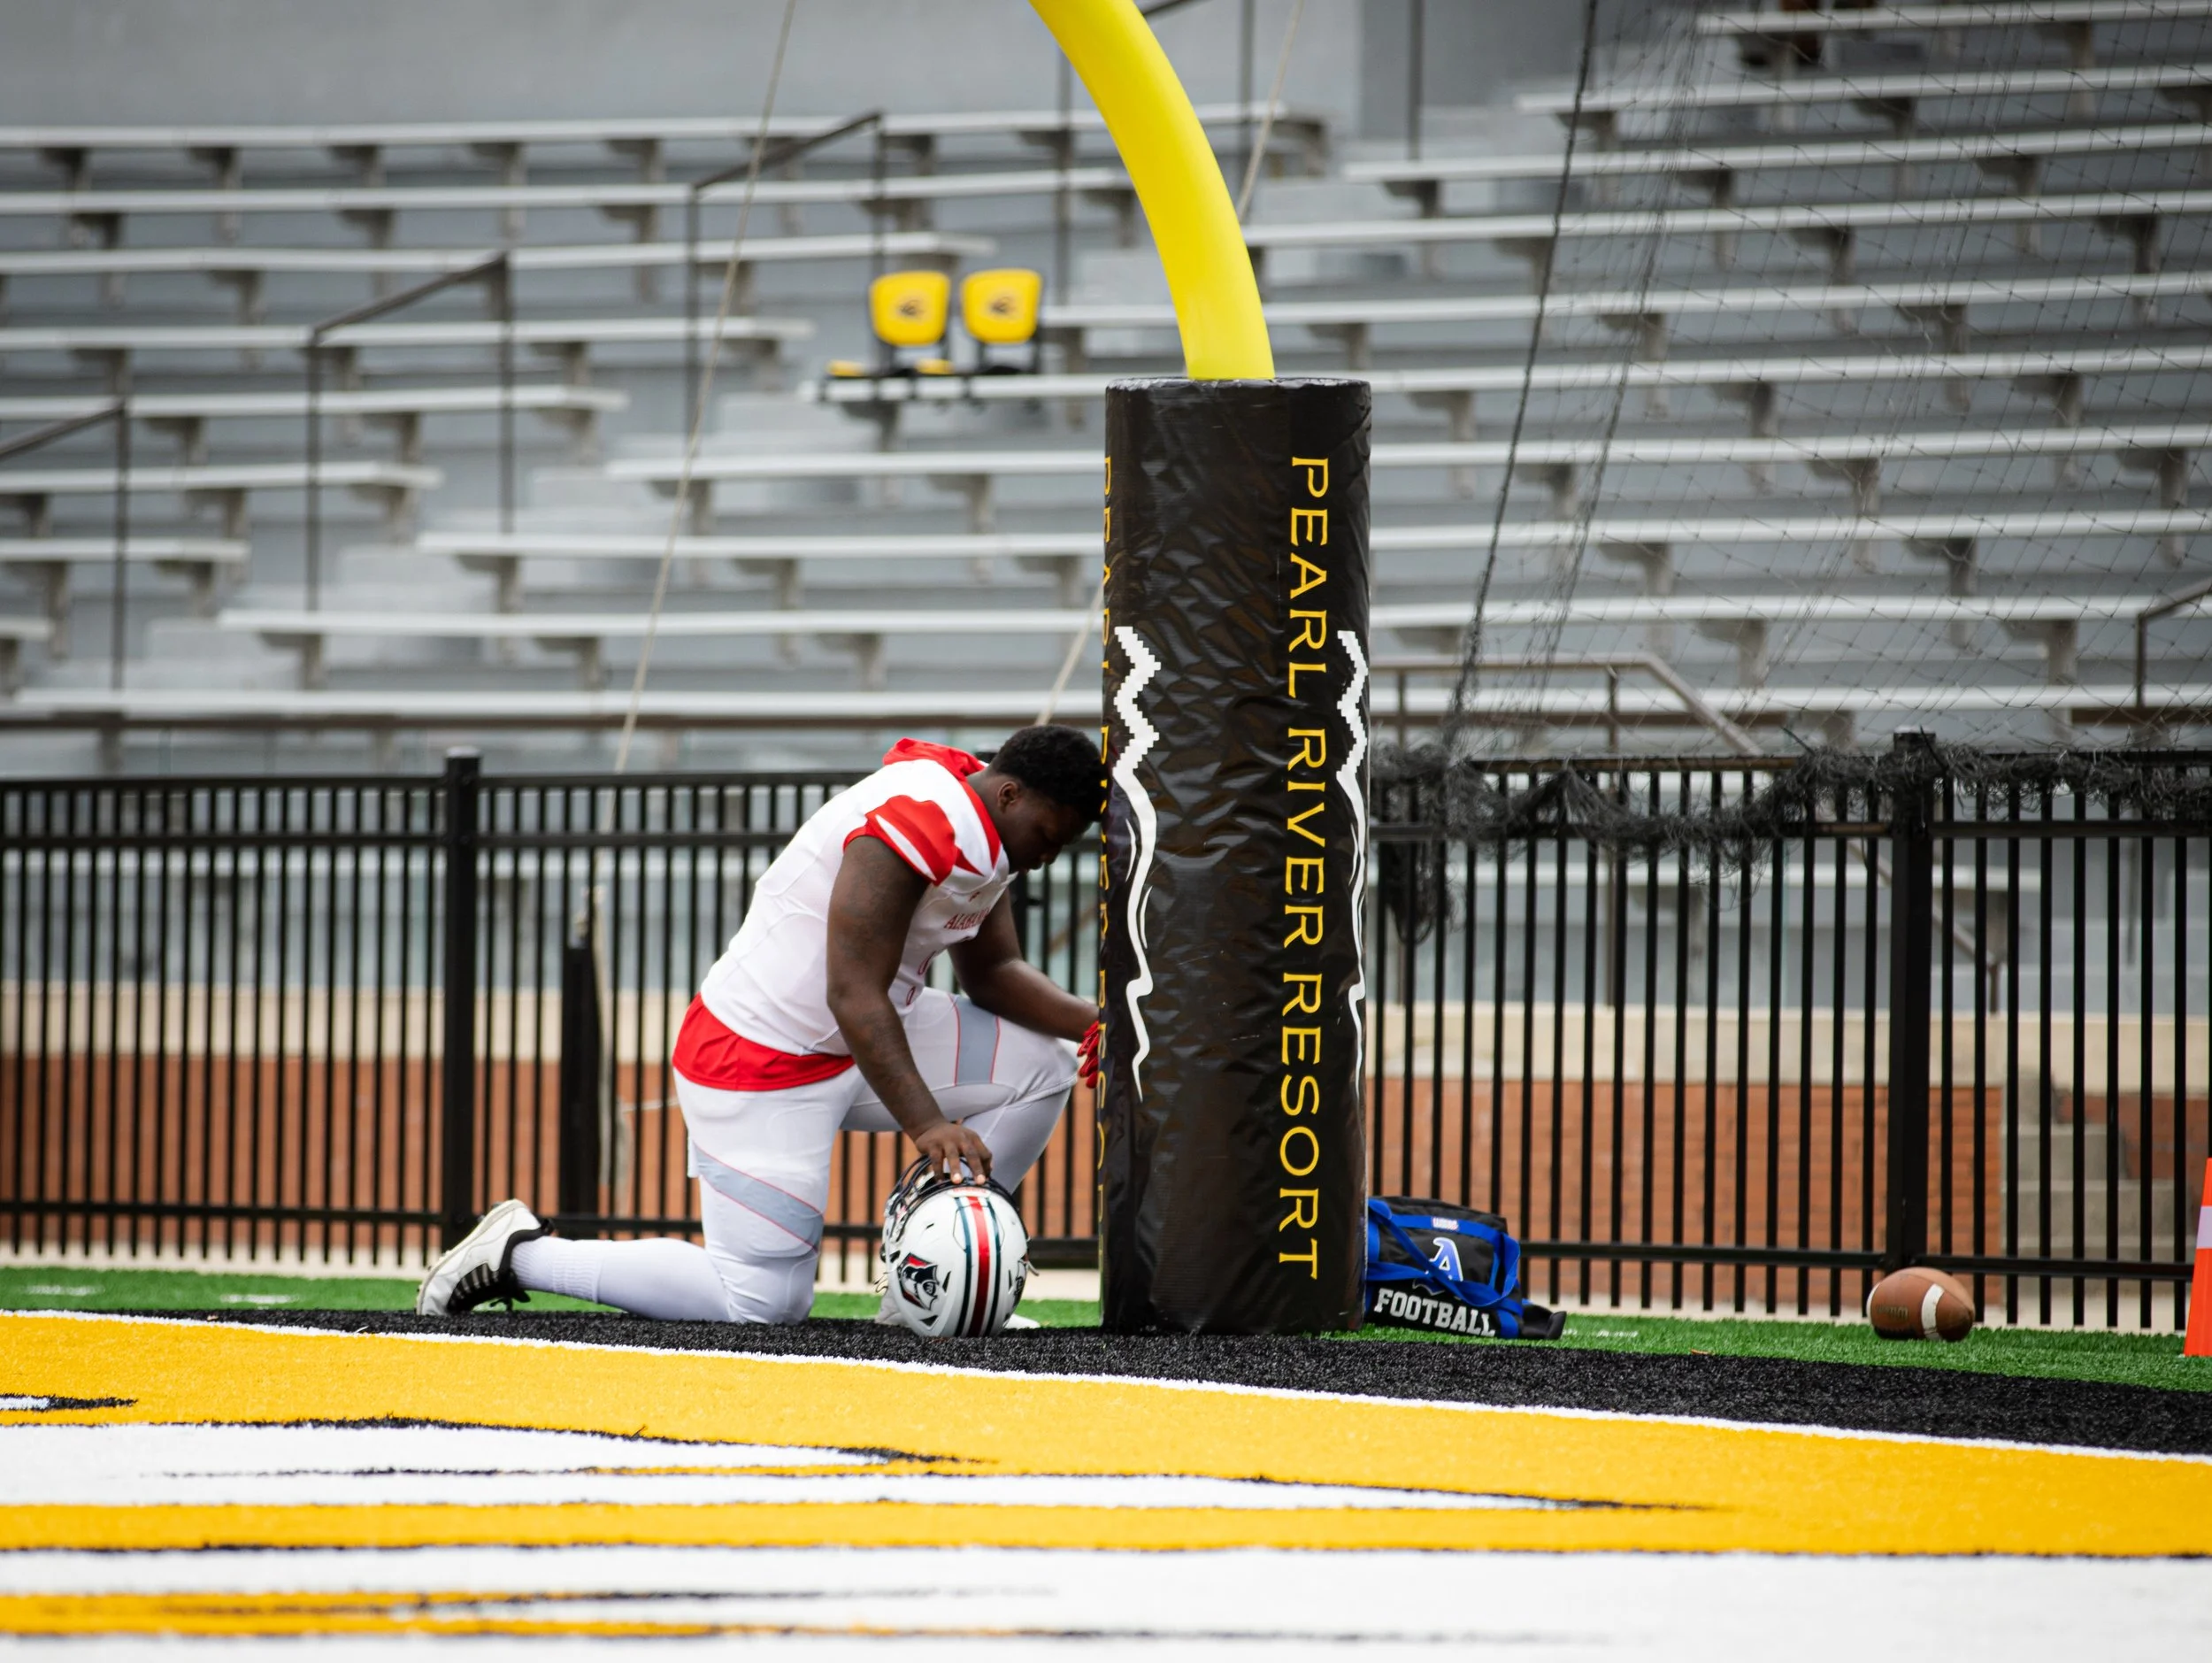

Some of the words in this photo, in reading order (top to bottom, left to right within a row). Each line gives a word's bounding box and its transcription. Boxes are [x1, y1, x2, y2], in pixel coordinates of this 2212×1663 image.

[1288, 457, 1329, 698] PEARL
[1283, 727, 1326, 949] RIVER
[1279, 972, 1323, 1280] RESORT
[1373, 1288, 1496, 1337] FOOTBALL
